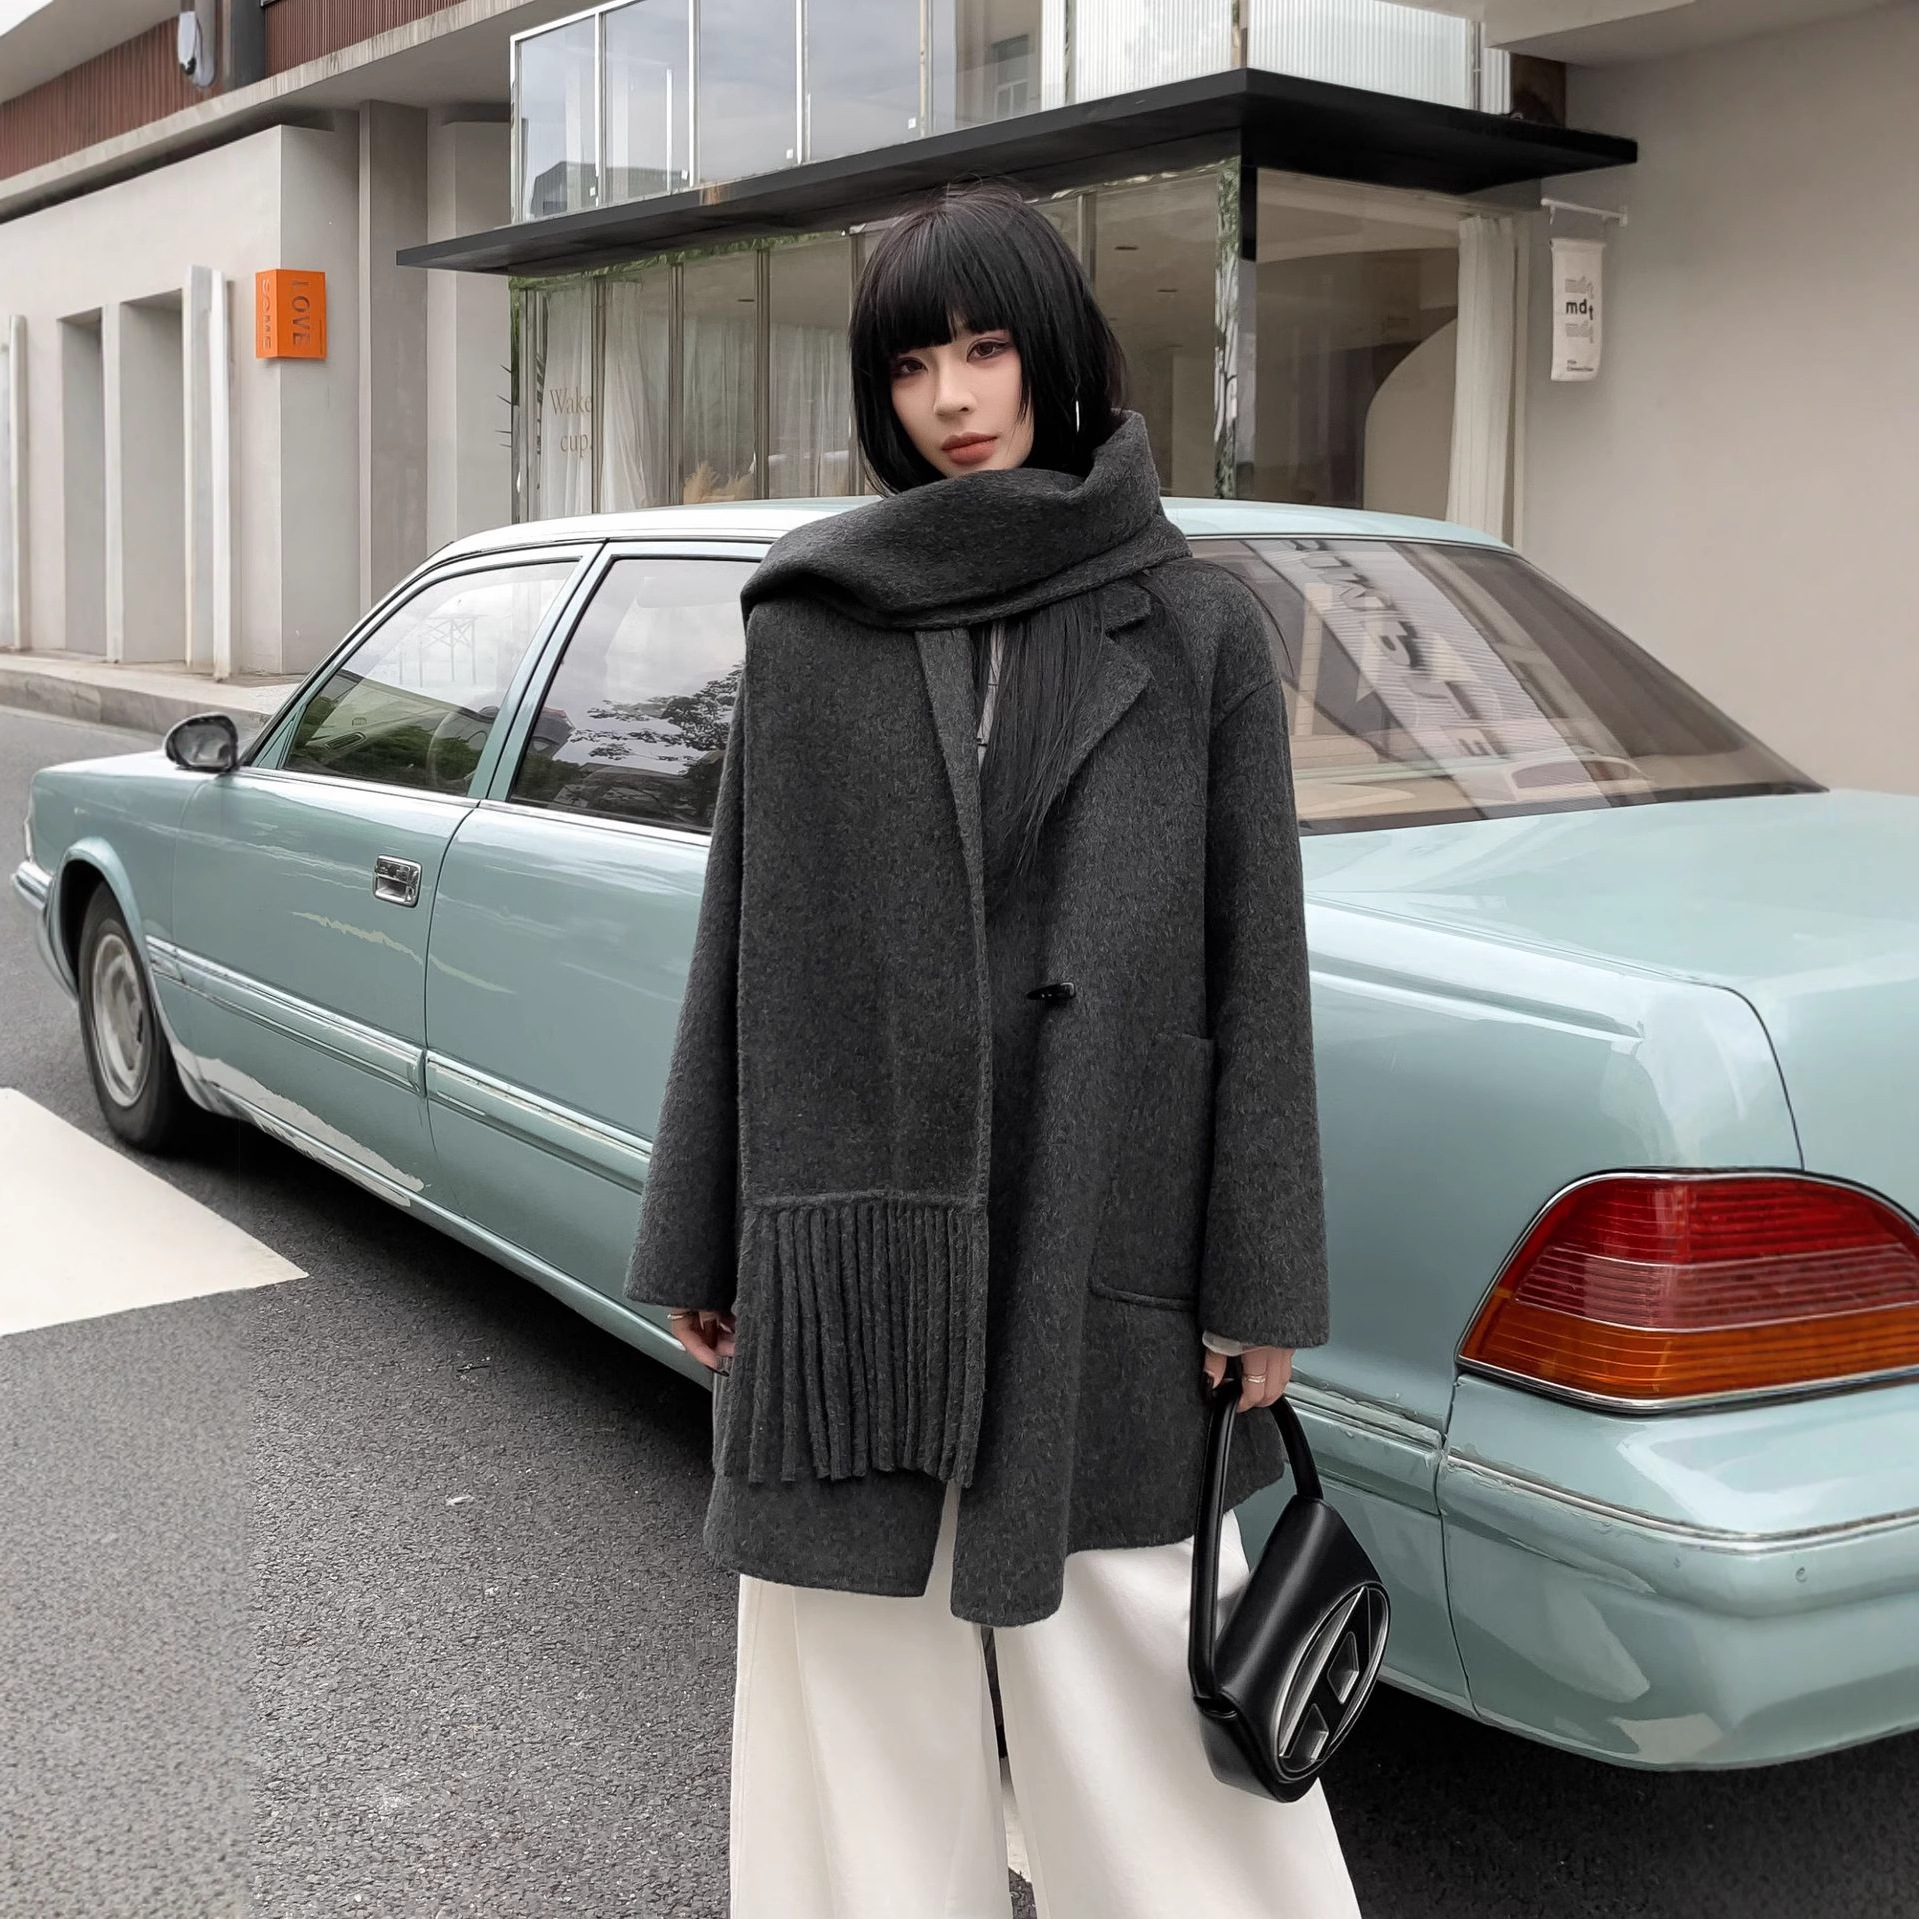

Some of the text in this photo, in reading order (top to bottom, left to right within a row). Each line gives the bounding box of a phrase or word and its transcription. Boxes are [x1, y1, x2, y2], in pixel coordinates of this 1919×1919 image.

[291, 280, 311, 346] LOVE
[1565, 298, 1594, 320] mdt
[549, 386, 592, 415] Wake
